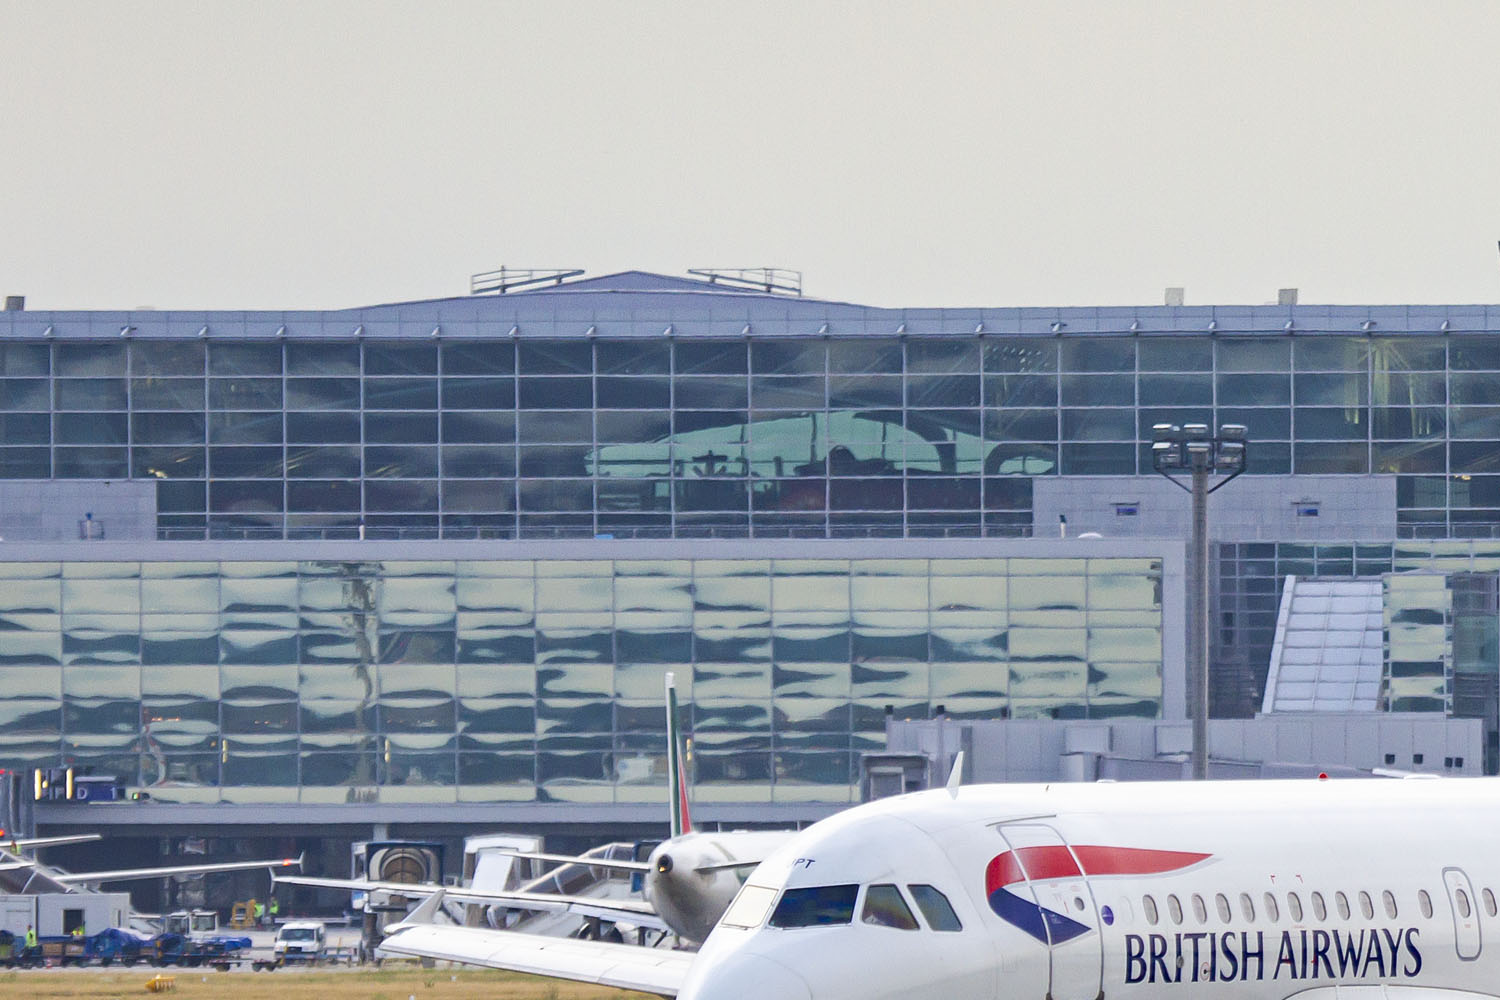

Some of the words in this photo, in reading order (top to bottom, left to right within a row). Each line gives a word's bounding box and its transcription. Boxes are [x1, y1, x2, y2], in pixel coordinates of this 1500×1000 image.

[77, 787, 88, 799] D
[792, 858, 816, 869] PT
[1124, 931, 1264, 984] BRITISH
[1273, 927, 1423, 980] AIRWAYS
